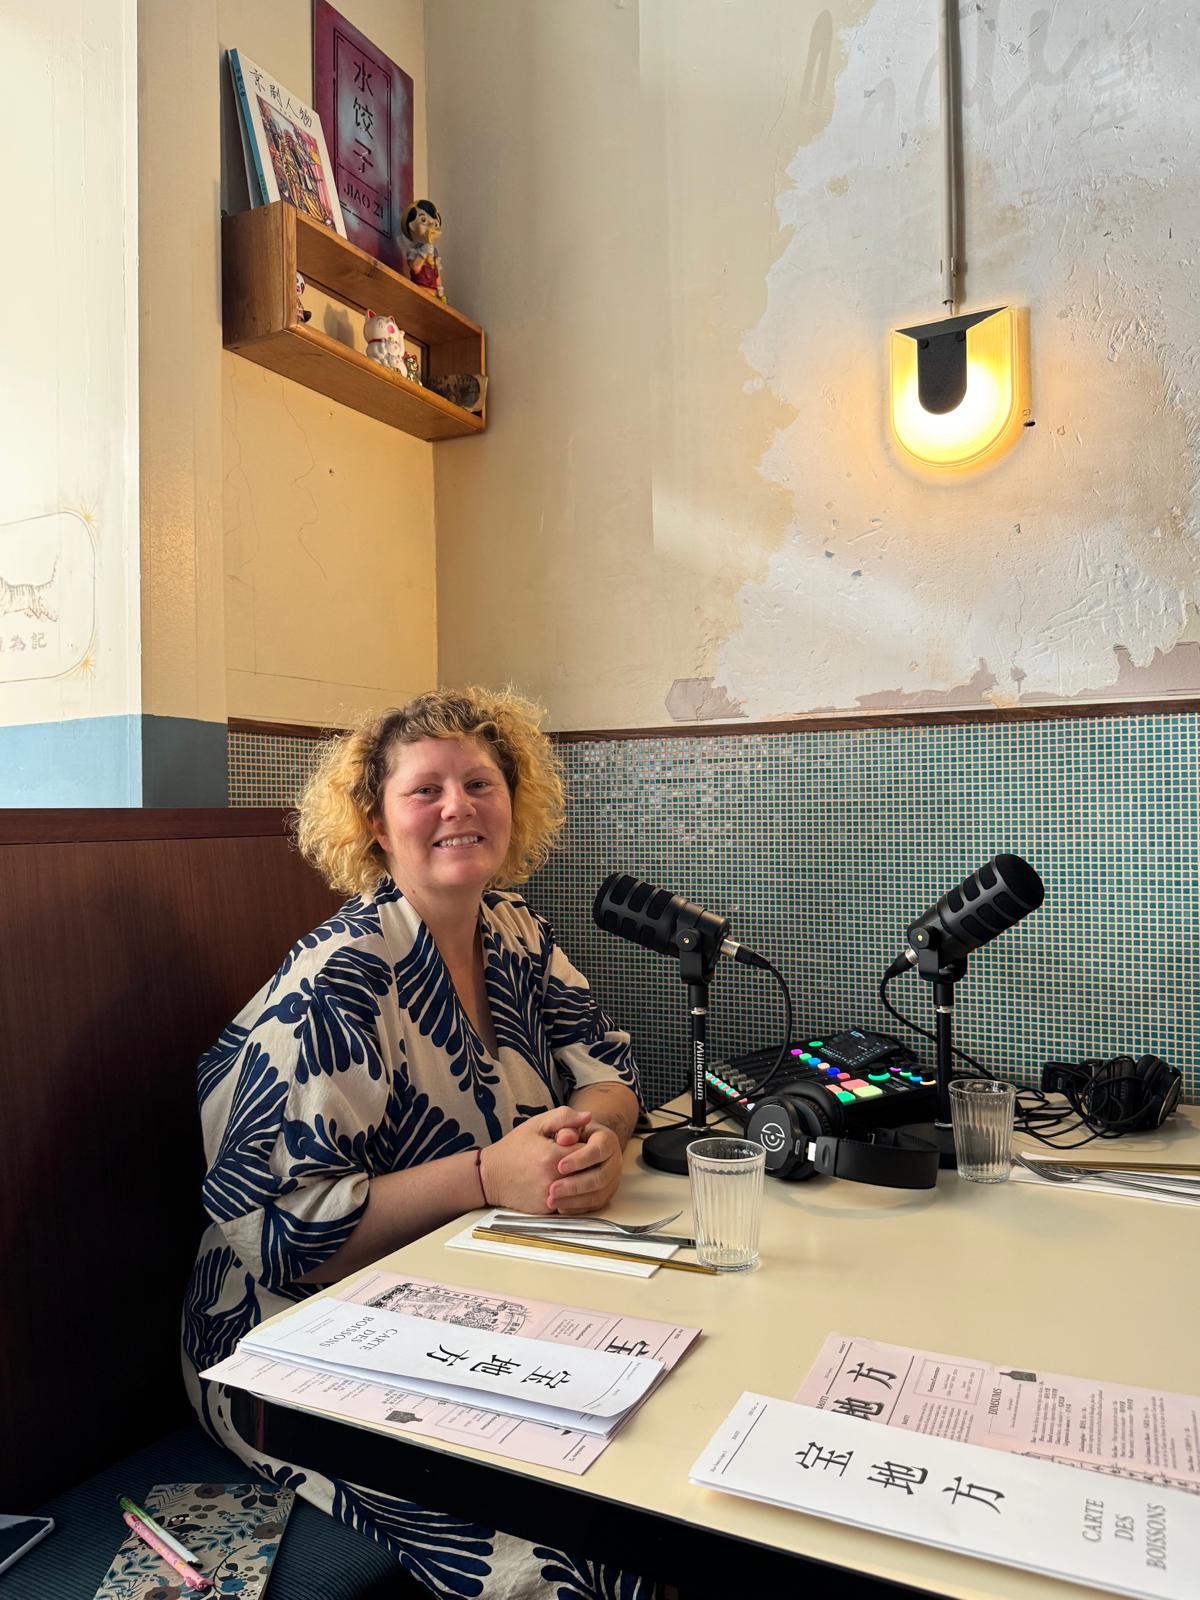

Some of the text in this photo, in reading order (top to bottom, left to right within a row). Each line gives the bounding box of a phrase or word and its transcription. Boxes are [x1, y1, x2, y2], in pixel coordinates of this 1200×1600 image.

[352, 61, 374, 173] 水饺子
[344, 182, 384, 220] JIAO ZI
[0, 631, 47, 653] 為記
[696, 1040, 705, 1100] Millenium
[319, 1316, 375, 1348] BOISSONS
[357, 1329, 376, 1343] DES
[360, 1328, 398, 1351] CARTE
[427, 1344, 570, 1389] 宝地方
[795, 1441, 1005, 1514] 宝地方
[1082, 1498, 1104, 1543] CARTE
[1114, 1514, 1135, 1542] DES
[1145, 1503, 1167, 1571] BOISSONS
